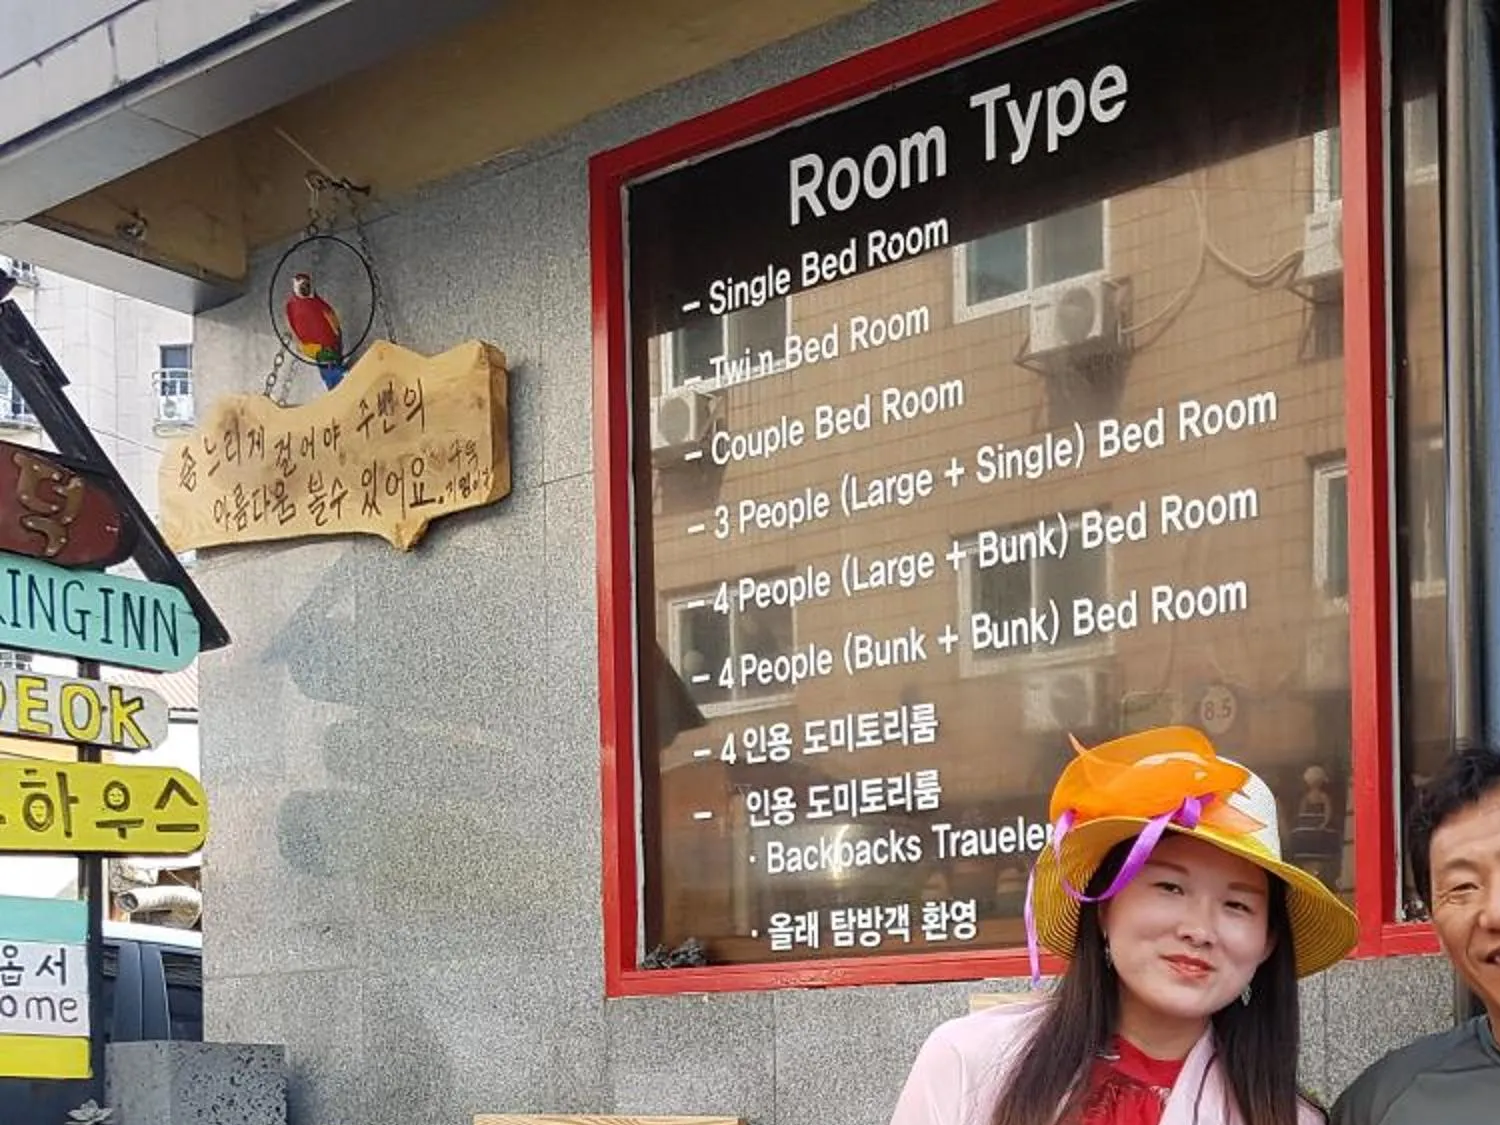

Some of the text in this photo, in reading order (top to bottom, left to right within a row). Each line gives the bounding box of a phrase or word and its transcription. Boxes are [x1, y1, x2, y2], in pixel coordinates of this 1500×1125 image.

[789, 62, 1130, 226] Room Type
[709, 264, 791, 315] Single
[801, 237, 857, 286] Bed
[867, 217, 949, 267] Room
[784, 322, 839, 370] Bed
[850, 304, 930, 352] Room
[711, 415, 804, 466] Couple
[814, 394, 871, 441] Bed
[882, 378, 964, 425] Room
[714, 507, 729, 541] 3
[738, 487, 830, 541] People
[841, 466, 934, 518] (Large
[976, 421, 1086, 486] Single)
[1098, 413, 1165, 460] Bed
[1178, 389, 1278, 441] Room
[714, 581, 731, 616] 4
[737, 563, 831, 614] People
[842, 541, 935, 594] (Large
[978, 510, 1069, 569] Bunk)
[1081, 501, 1147, 549] Bed
[1160, 485, 1258, 535] Room
[0, 569, 180, 657] ING INN
[718, 658, 733, 689] 4
[741, 643, 832, 690] People
[843, 628, 927, 673] (Bunk
[971, 601, 1060, 651] Bunk)
[1073, 595, 1137, 638] Bed
[1151, 579, 1248, 624] Room
[0, 675, 152, 751] EOK
[802, 703, 938, 756] 도미토리룸
[0, 770, 199, 839] 하우스
[746, 787, 797, 828] 인용
[806, 769, 942, 820] 도미토리룸
[767, 899, 977, 951] 올래 탐방객 환영
